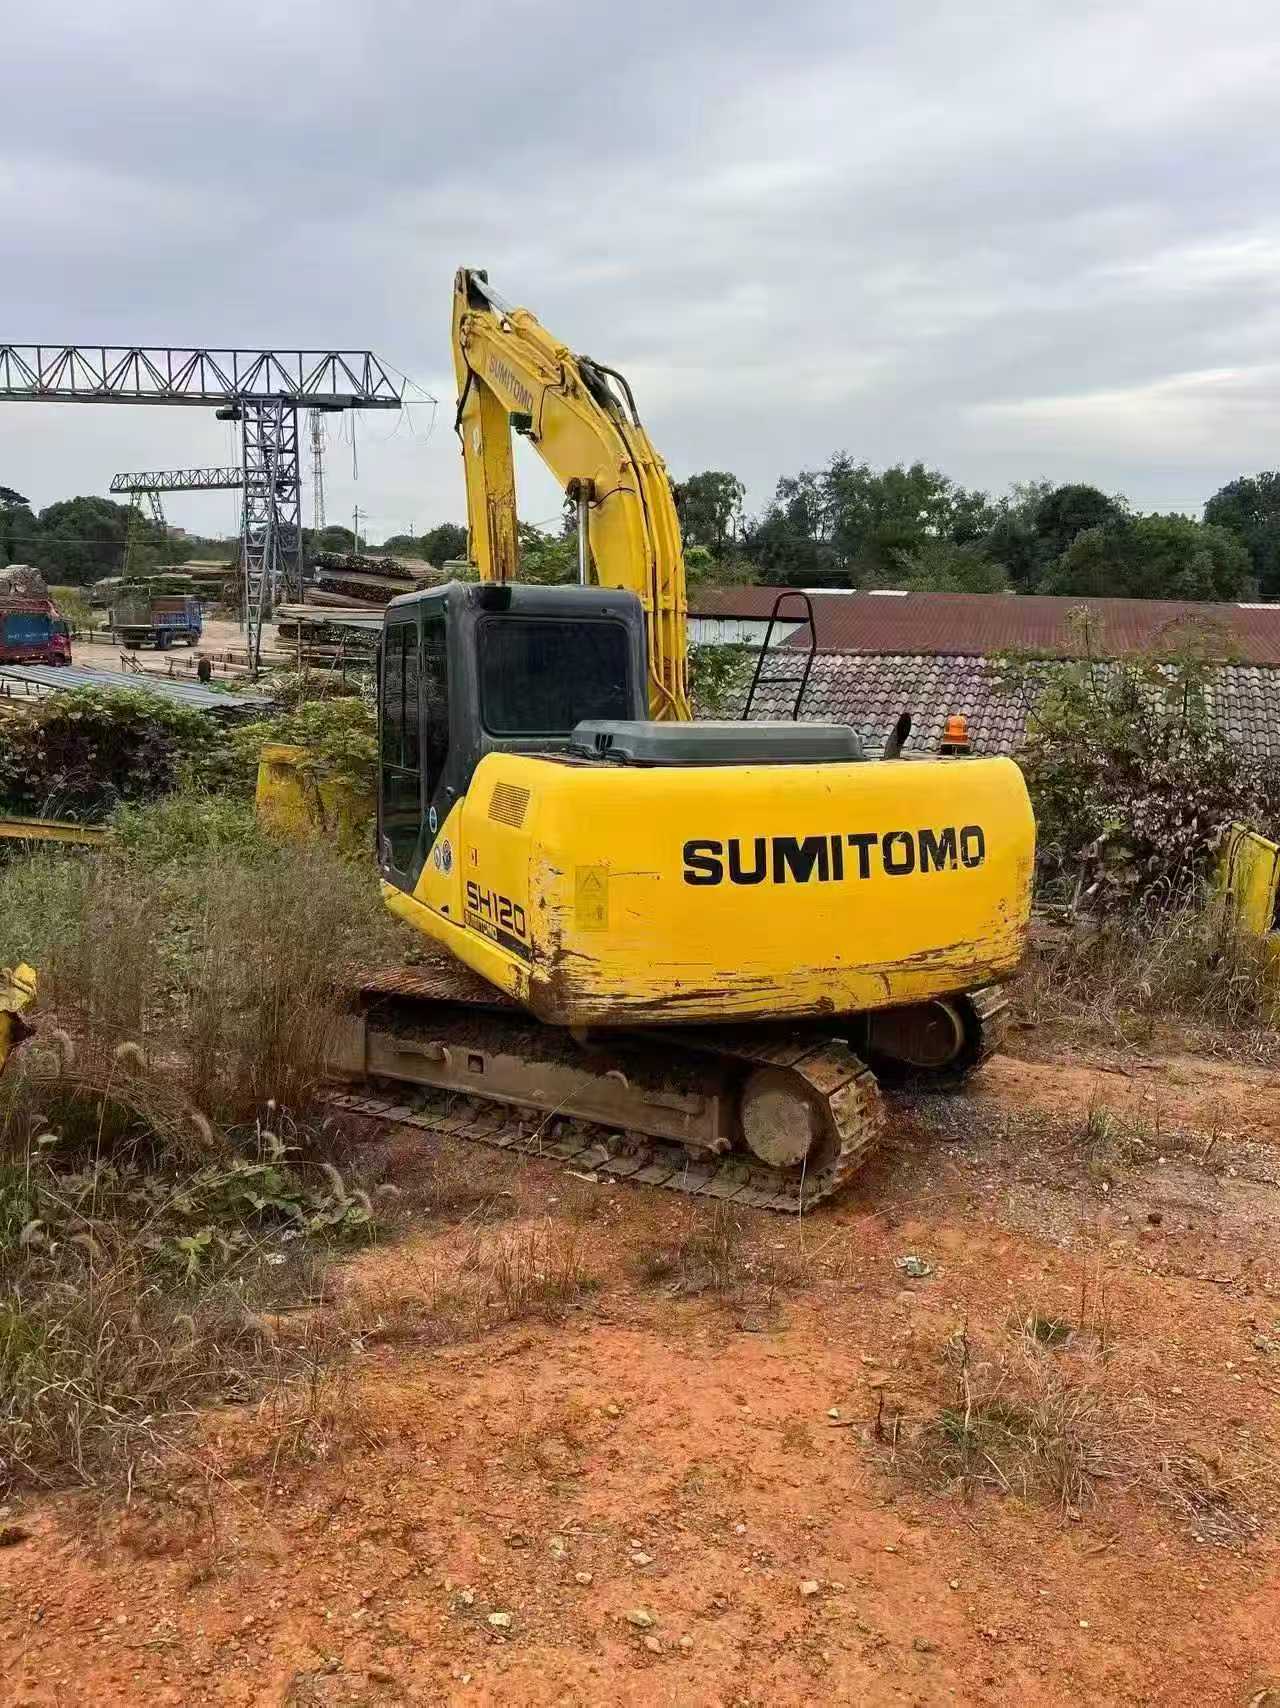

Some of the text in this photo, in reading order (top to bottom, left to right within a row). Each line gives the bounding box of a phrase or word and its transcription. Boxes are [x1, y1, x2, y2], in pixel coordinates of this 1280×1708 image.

[489, 353, 534, 410] SUMITOMO
[683, 825, 985, 886] SUMITOMO
[467, 880, 526, 938] SH120
